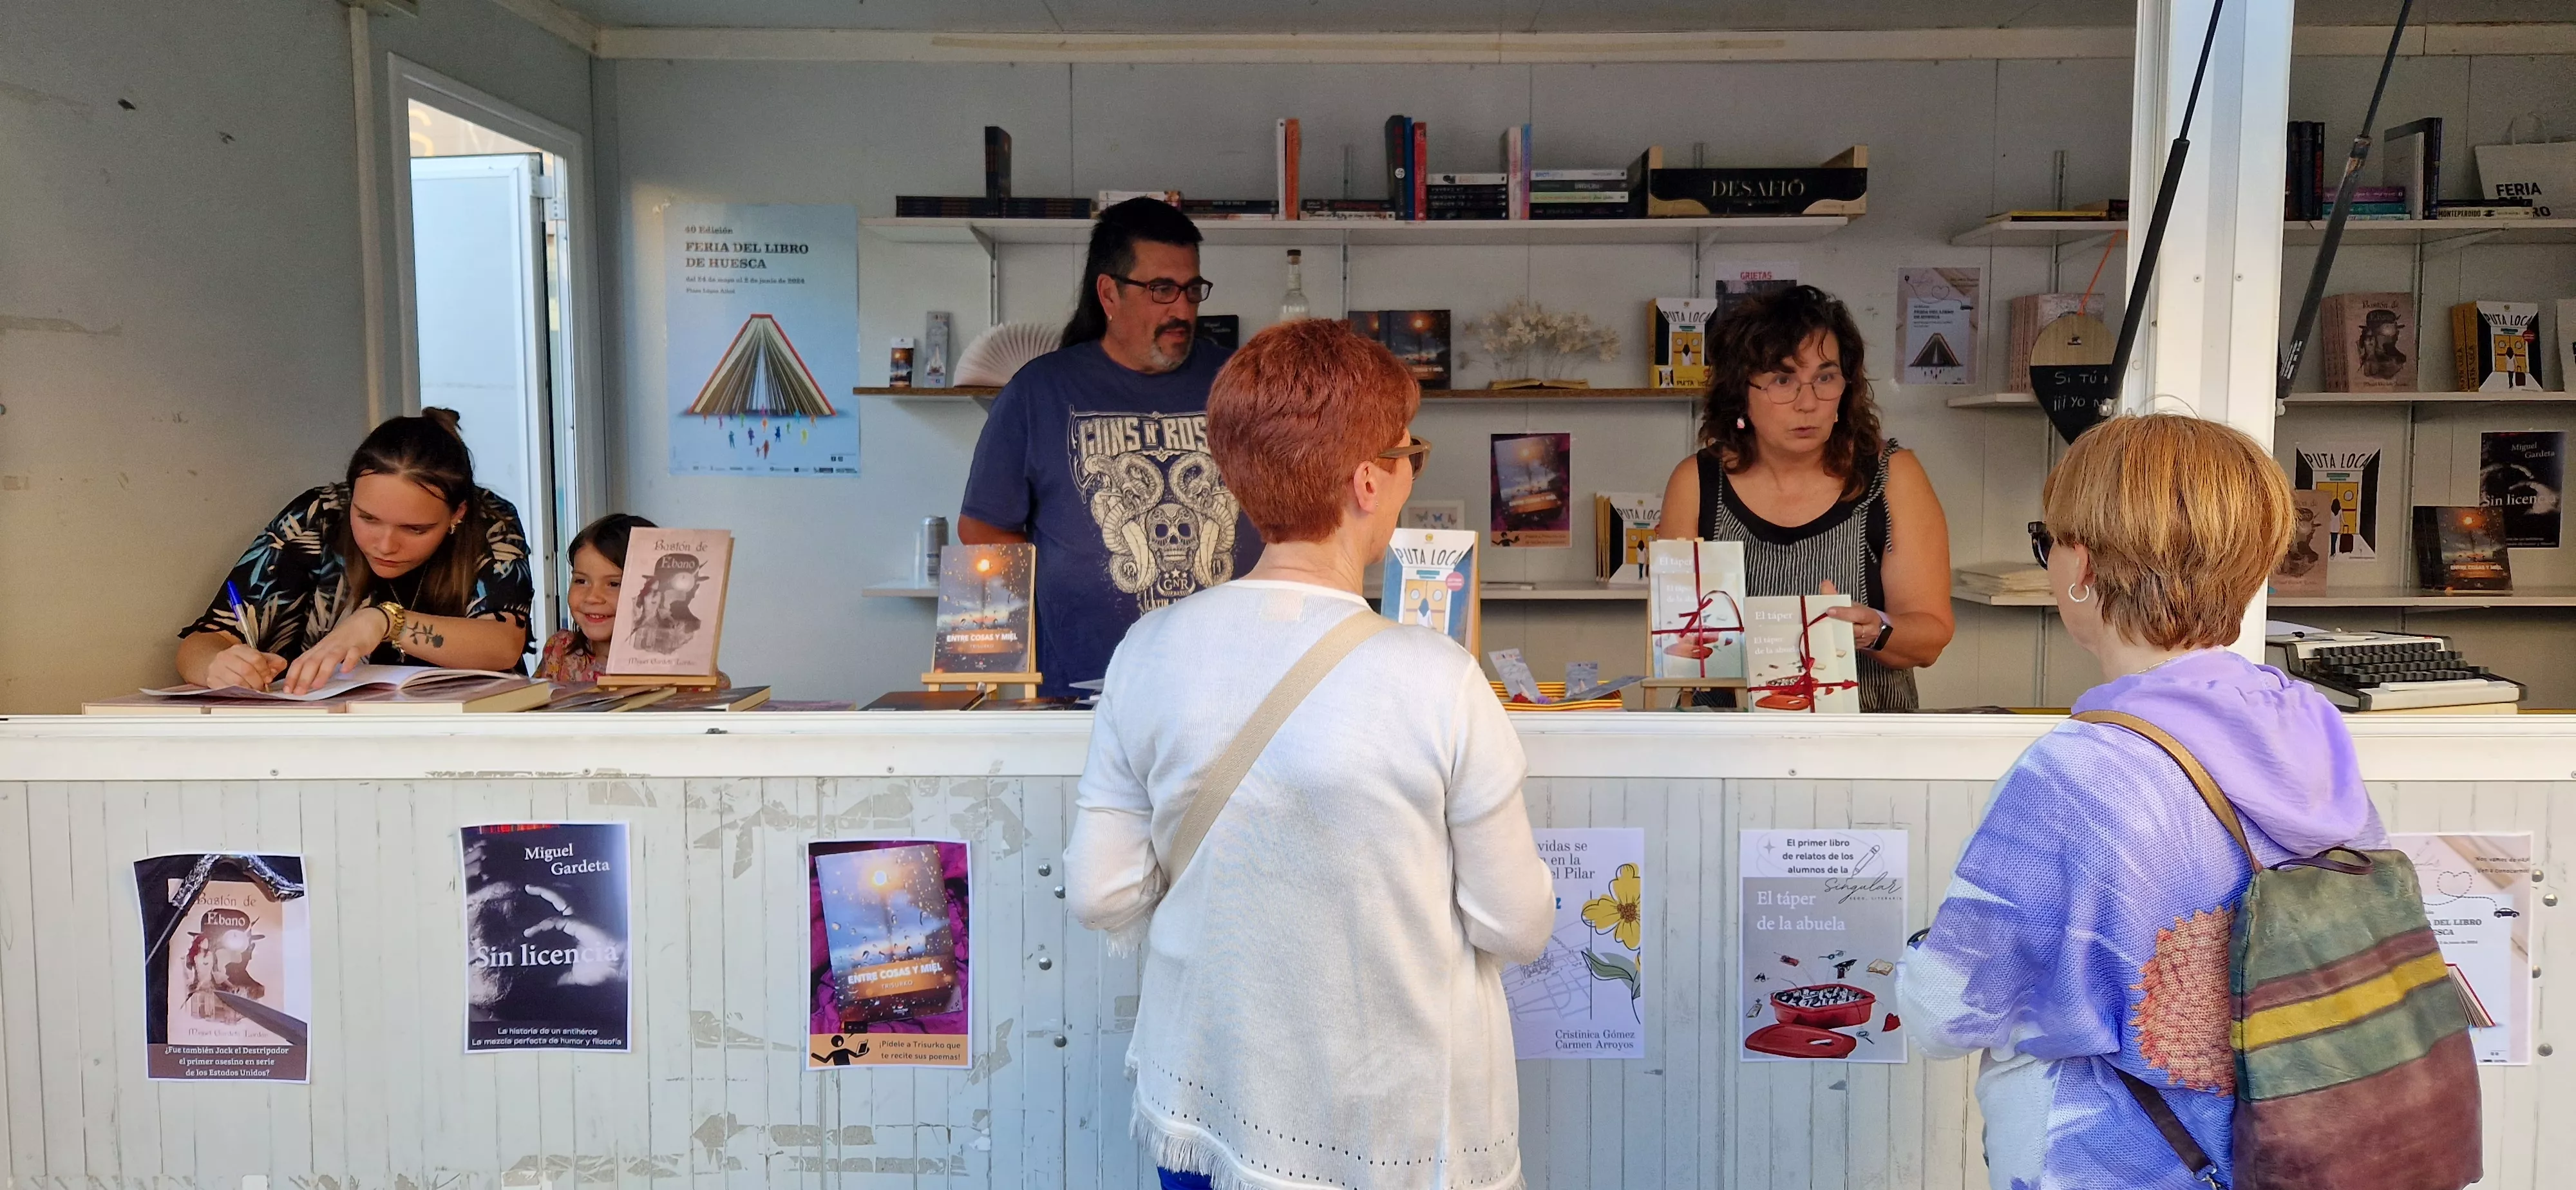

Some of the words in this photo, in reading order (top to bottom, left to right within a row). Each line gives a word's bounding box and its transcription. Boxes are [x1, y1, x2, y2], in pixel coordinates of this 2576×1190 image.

[2496, 182, 2542, 196] FERIA
[685, 242, 729, 252] FERIA
[733, 243, 761, 253] DEL
[765, 244, 809, 254] LIBRO
[685, 258, 705, 267] DE
[709, 258, 766, 269] HUESCA
[1663, 311, 1685, 321] PUTA
[2483, 314, 2507, 325] PUTA
[2510, 315, 2532, 325] LOCA
[2079, 370, 2096, 383] TÚ
[1079, 417, 1142, 457] GUNS
[1162, 417, 1209, 451] ROS
[2512, 442, 2537, 451] Miguel
[2304, 453, 2336, 468] PUTA
[2341, 453, 2372, 468] LOCA
[2485, 496, 2503, 506] Sin
[1616, 508, 1639, 520] PUTA
[1643, 509, 1660, 520] LOC
[654, 539, 690, 551] Bastón
[696, 542, 708, 551] de
[1395, 548, 1426, 565] PUTA
[1431, 549, 1463, 565] LOCA
[1660, 557, 1668, 565] El
[1164, 580, 1189, 590] GNR
[1756, 611, 1765, 619] El
[1768, 611, 1792, 622] táper
[1538, 840, 1570, 851] vidas
[1575, 842, 1587, 851] se
[1798, 840, 1827, 848] primer
[524, 843, 574, 862] Miguel
[1551, 856, 1565, 865] en
[1570, 853, 1580, 865] la
[551, 860, 610, 876] Gardeta
[1565, 867, 1595, 879] Pilar
[1824, 871, 1901, 904] Singular
[196, 892, 236, 906] Bastón
[243, 894, 257, 906] de
[1757, 891, 1773, 905] El
[1777, 892, 1816, 910] táper
[1757, 917, 1775, 930] de
[1779, 917, 1792, 930] la
[1797, 917, 1846, 930] abuela
[477, 945, 514, 967] Sin
[520, 943, 620, 967] licencia
[848, 972, 878, 984] ENTRE
[880, 967, 911, 979] COSAS
[920, 962, 943, 974] MIEL
[881, 980, 913, 989] TRISURKO
[1603, 1030, 1635, 1039] Gómez
[514, 1037, 546, 1046] perfecta
[880, 1040, 904, 1048] ¡Pídele
[1555, 1040, 1592, 1049] Carmen
[1596, 1040, 1634, 1051] Arroyos
